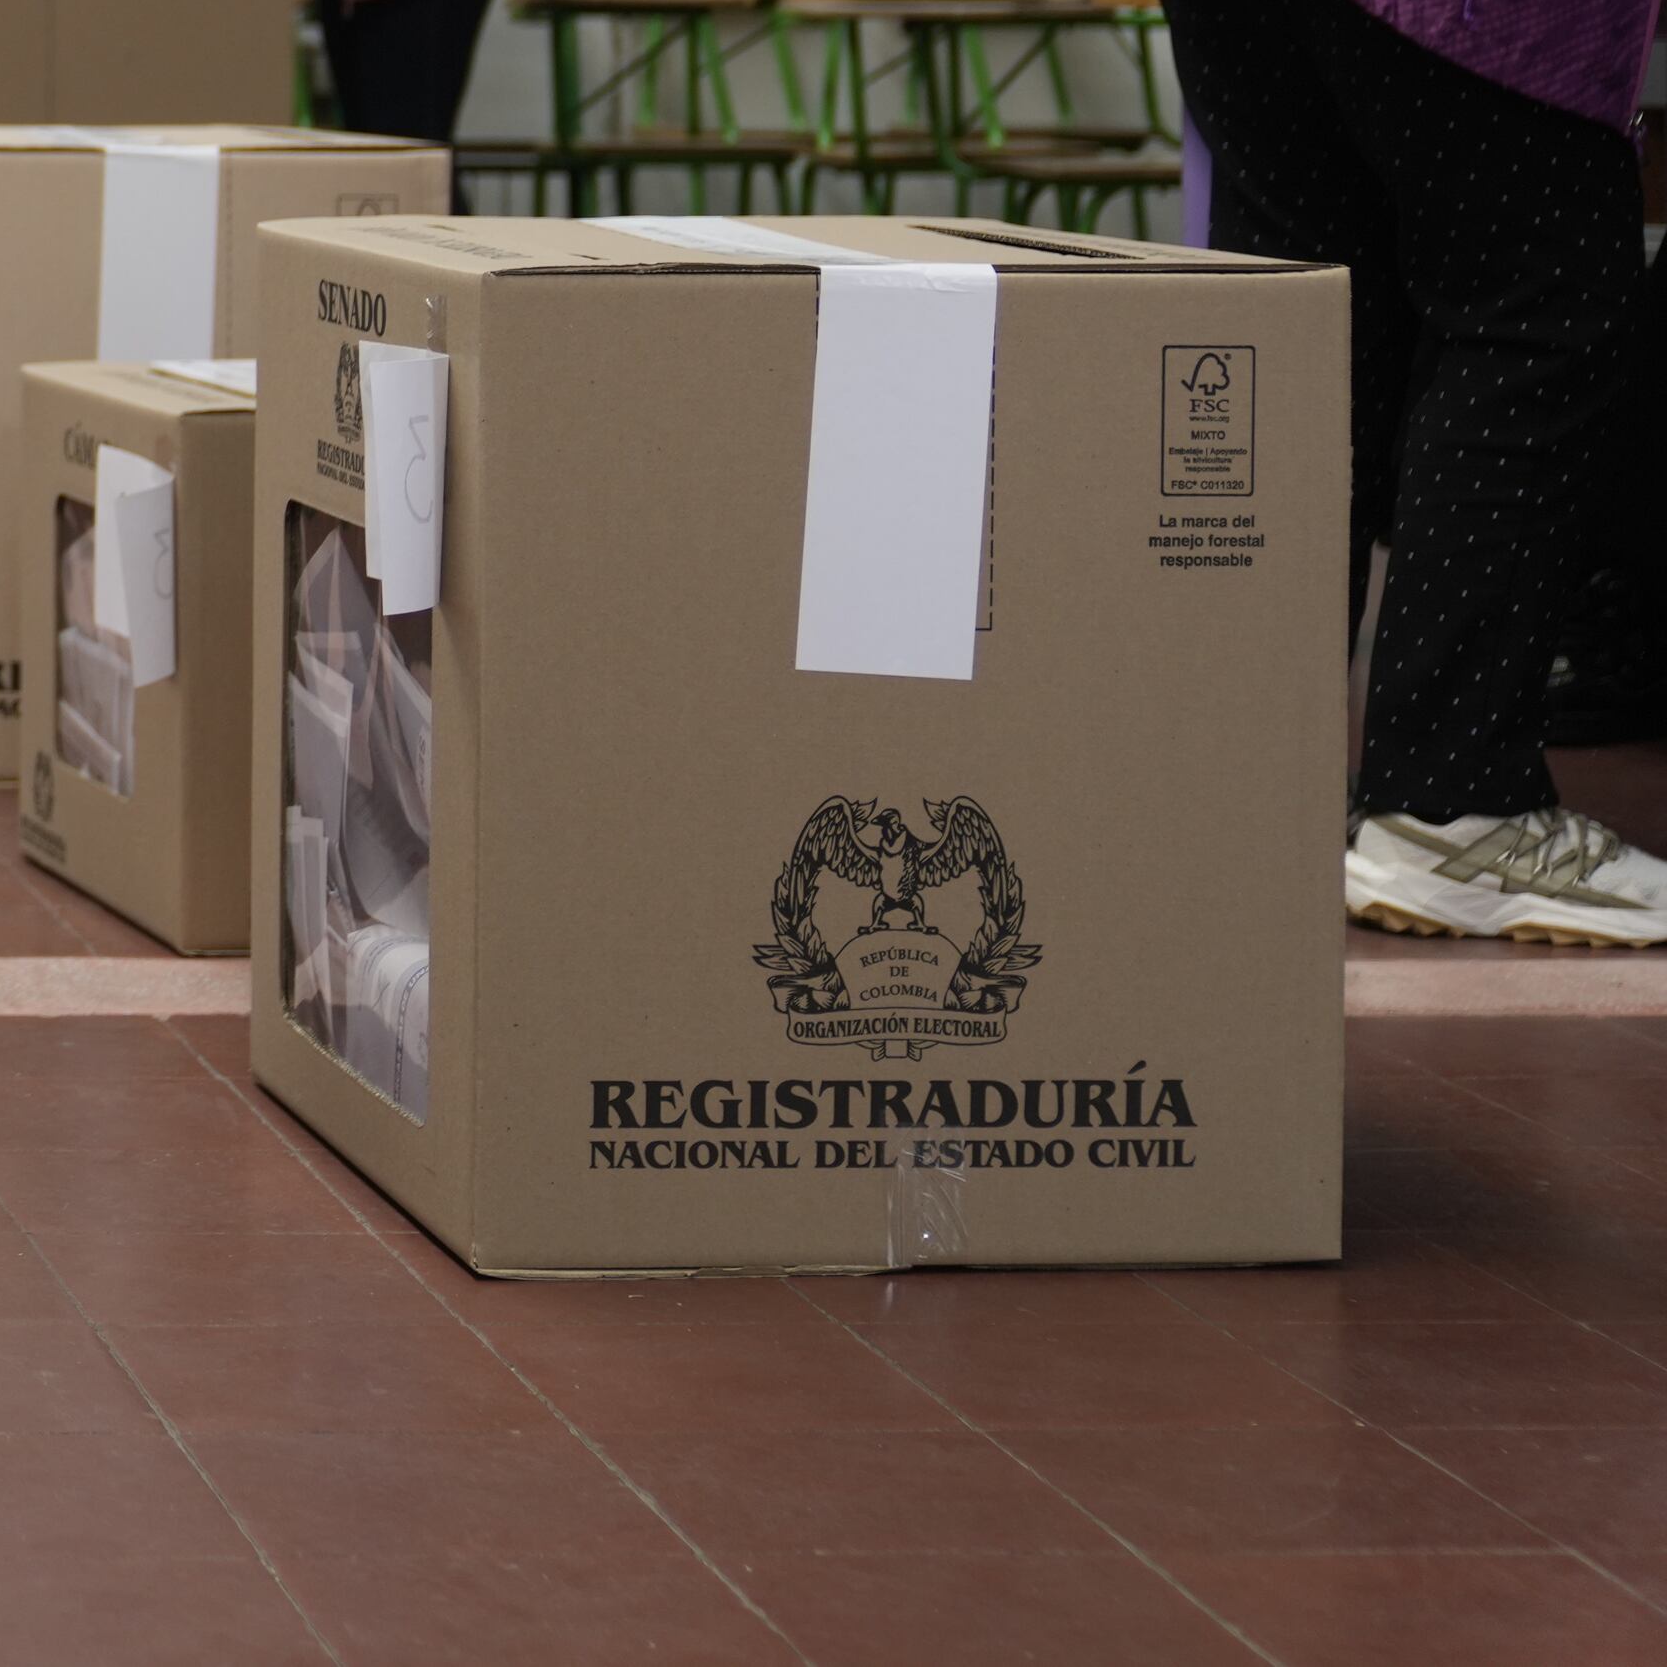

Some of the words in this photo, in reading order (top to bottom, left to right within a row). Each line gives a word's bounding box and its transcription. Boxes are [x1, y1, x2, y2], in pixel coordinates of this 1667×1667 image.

[318, 278, 387, 338] SENADO
[1189, 399, 1230, 413] FSC
[1191, 431, 1226, 440] MIXTO
[1210, 448, 1247, 456] Apoyando
[1185, 465, 1231, 473] responsable
[1200, 481, 1244, 489] C011320
[1159, 514, 1177, 527] La
[1182, 517, 1227, 527] marca
[1232, 514, 1255, 527] del
[1149, 534, 1203, 549] manejo
[1208, 534, 1265, 547] forestal
[1160, 553, 1253, 570] responsable
[860, 946, 939, 968] REPÚBLICA
[890, 966, 909, 977] DE
[859, 984, 937, 1003] COLOMBIA
[793, 1012, 908, 1038] ORGANIZACIÓN
[914, 1017, 1001, 1038] ELECTORAL
[589, 1060, 1198, 1130] REGISTRADURÍA
[589, 1137, 800, 1171] NACIONAL
[814, 1138, 898, 1170] DEL
[913, 1138, 1074, 1171] ESTADO
[1088, 1136, 1196, 1170] CIVIL
